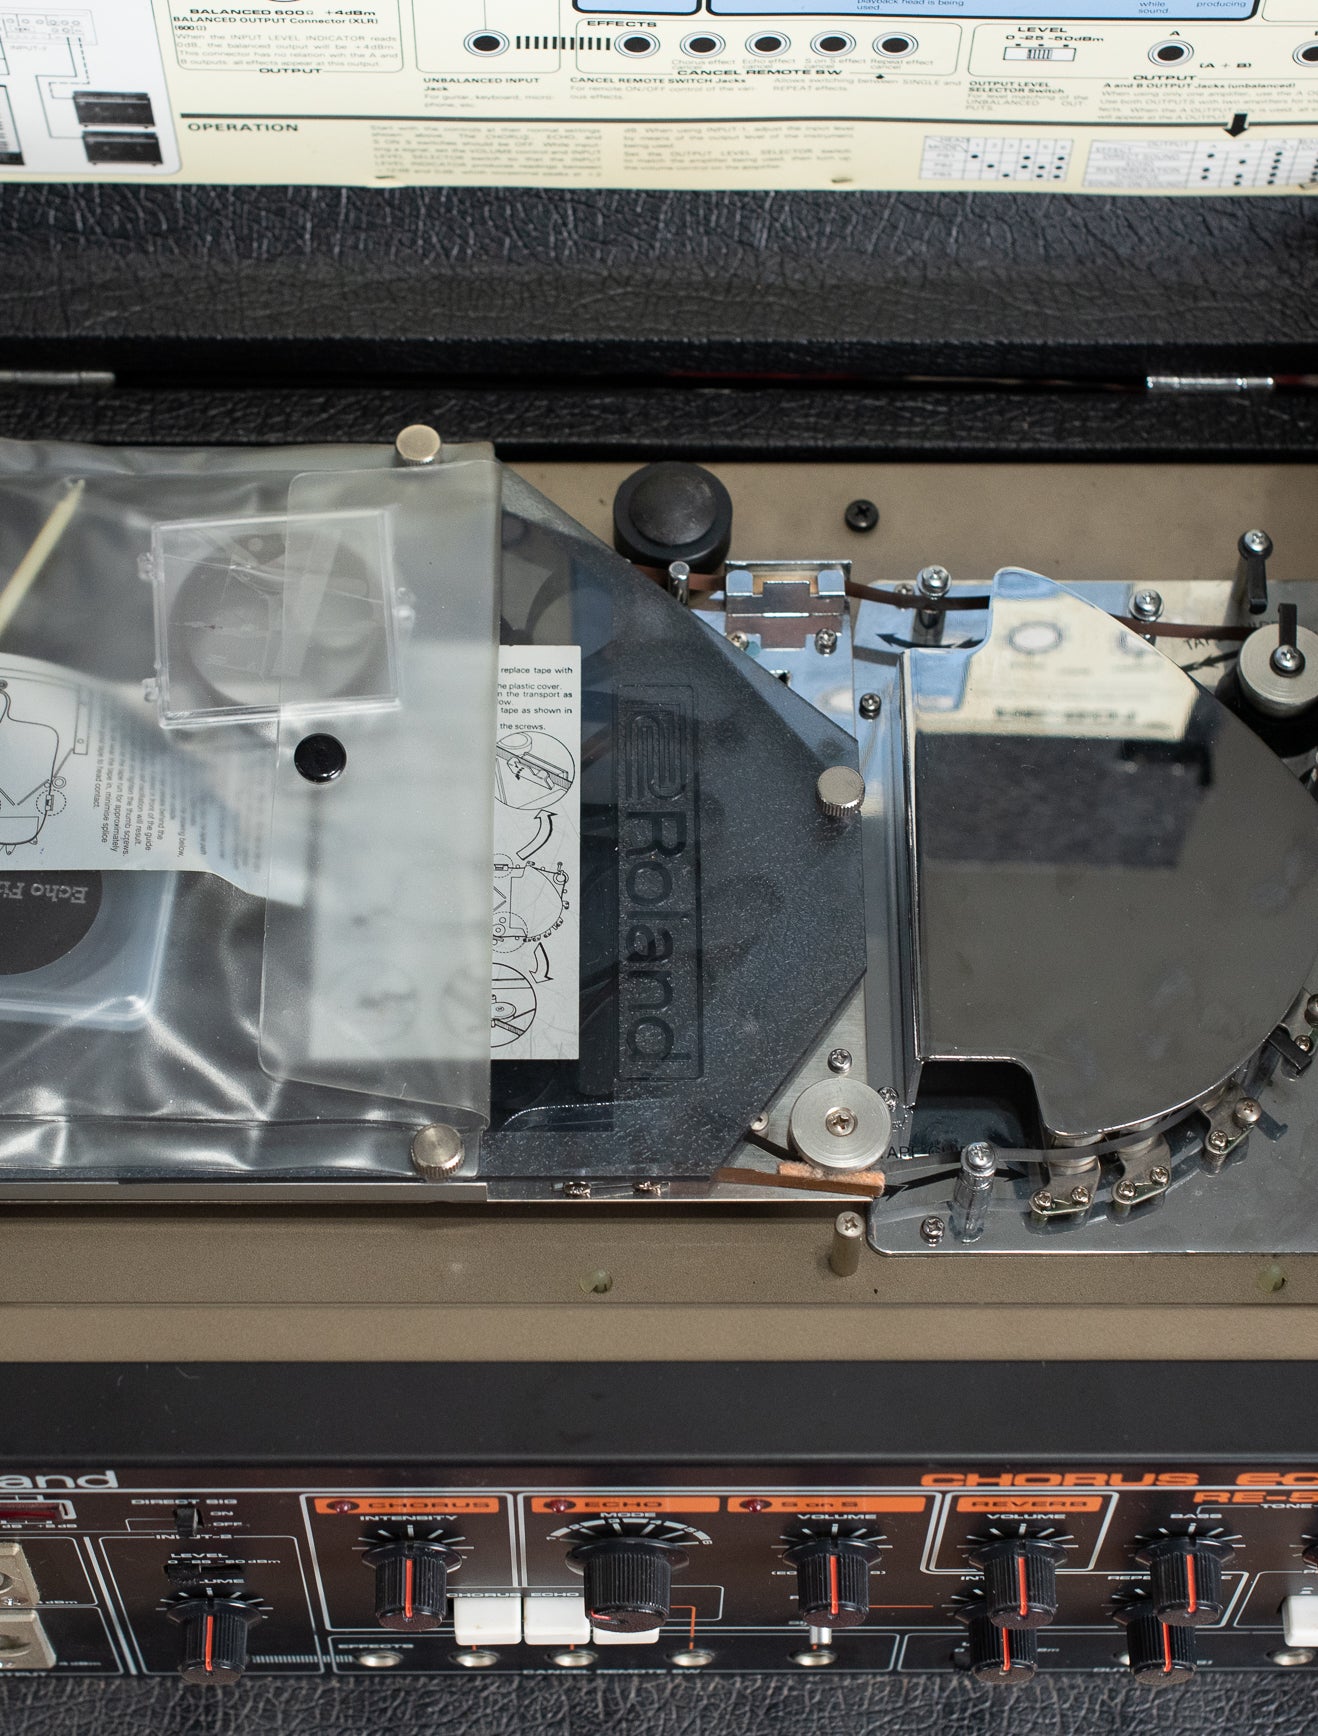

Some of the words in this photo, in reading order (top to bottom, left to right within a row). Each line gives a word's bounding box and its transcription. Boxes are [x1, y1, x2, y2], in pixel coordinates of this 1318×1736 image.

[587, 20, 657, 28] EFFECTS
[305, 34, 366, 42] INDICATOR
[188, 123, 299, 132] OPERATION
[509, 683, 535, 691] plastic
[110, 804, 122, 852] approximately
[0, 881, 26, 900] Fi
[30, 883, 89, 904] Echo
[625, 810, 693, 1063] Roland
[920, 1472, 1199, 1487] CHORUS
